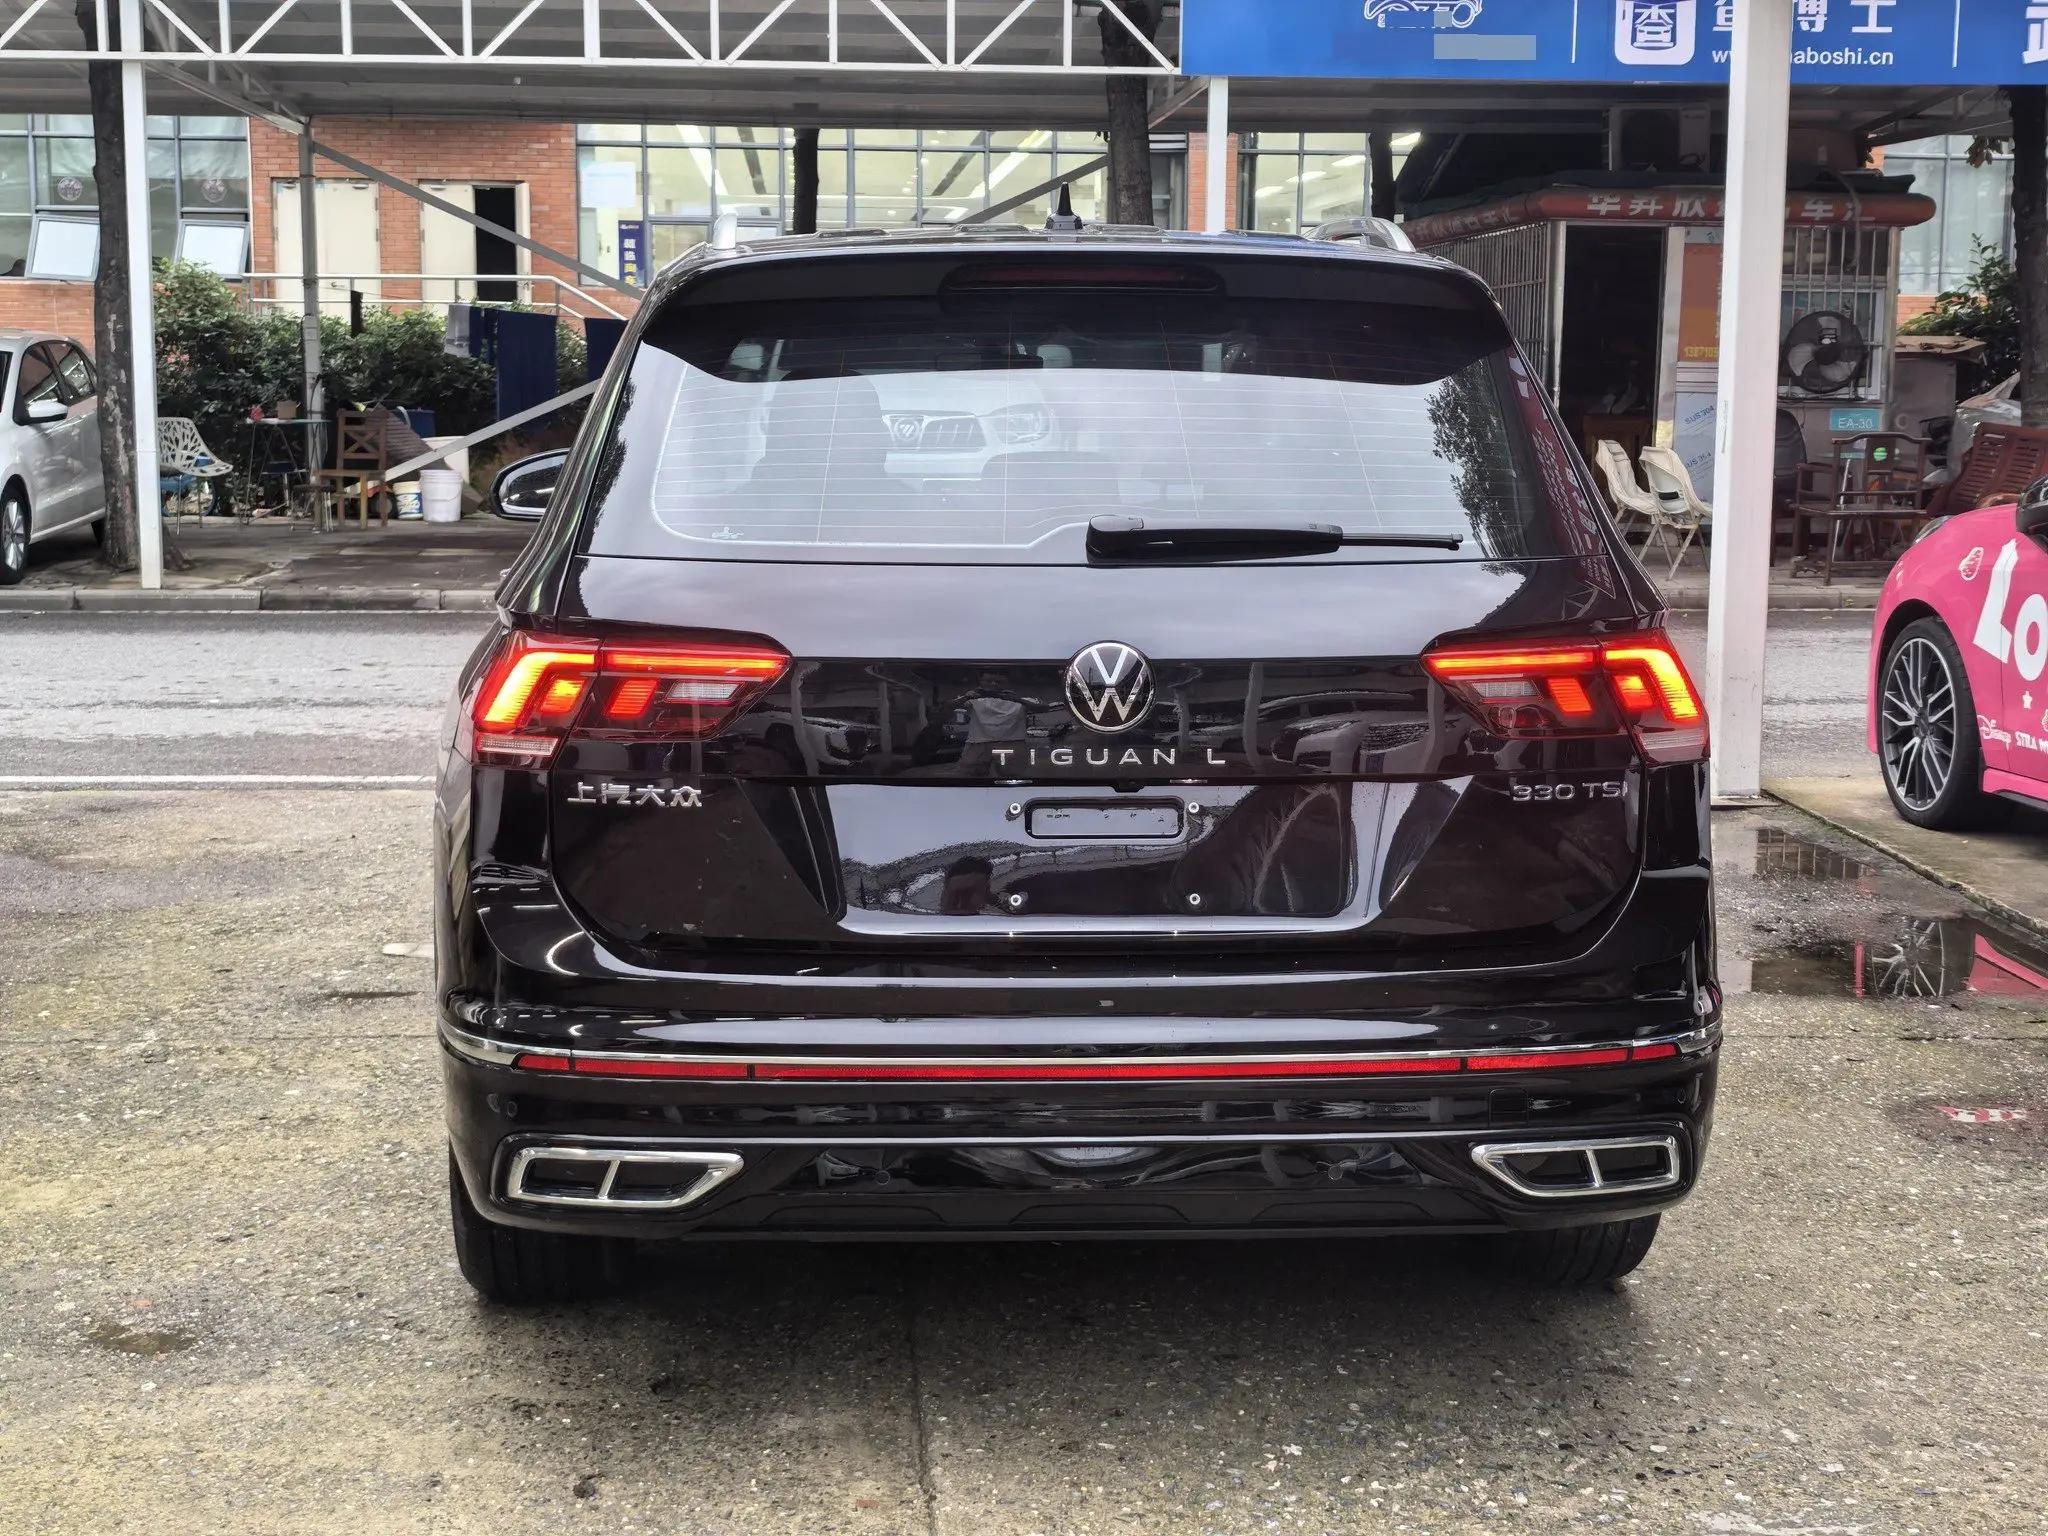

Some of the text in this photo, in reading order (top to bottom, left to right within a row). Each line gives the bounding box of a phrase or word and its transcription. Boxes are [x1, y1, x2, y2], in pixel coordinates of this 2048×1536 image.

[1711, 47, 1894, 65] waboshi.cn
[992, 748, 1226, 766] TIGUAN L
[567, 781, 703, 807] 上汽大众
[1512, 780, 1628, 802] 330 TSI
